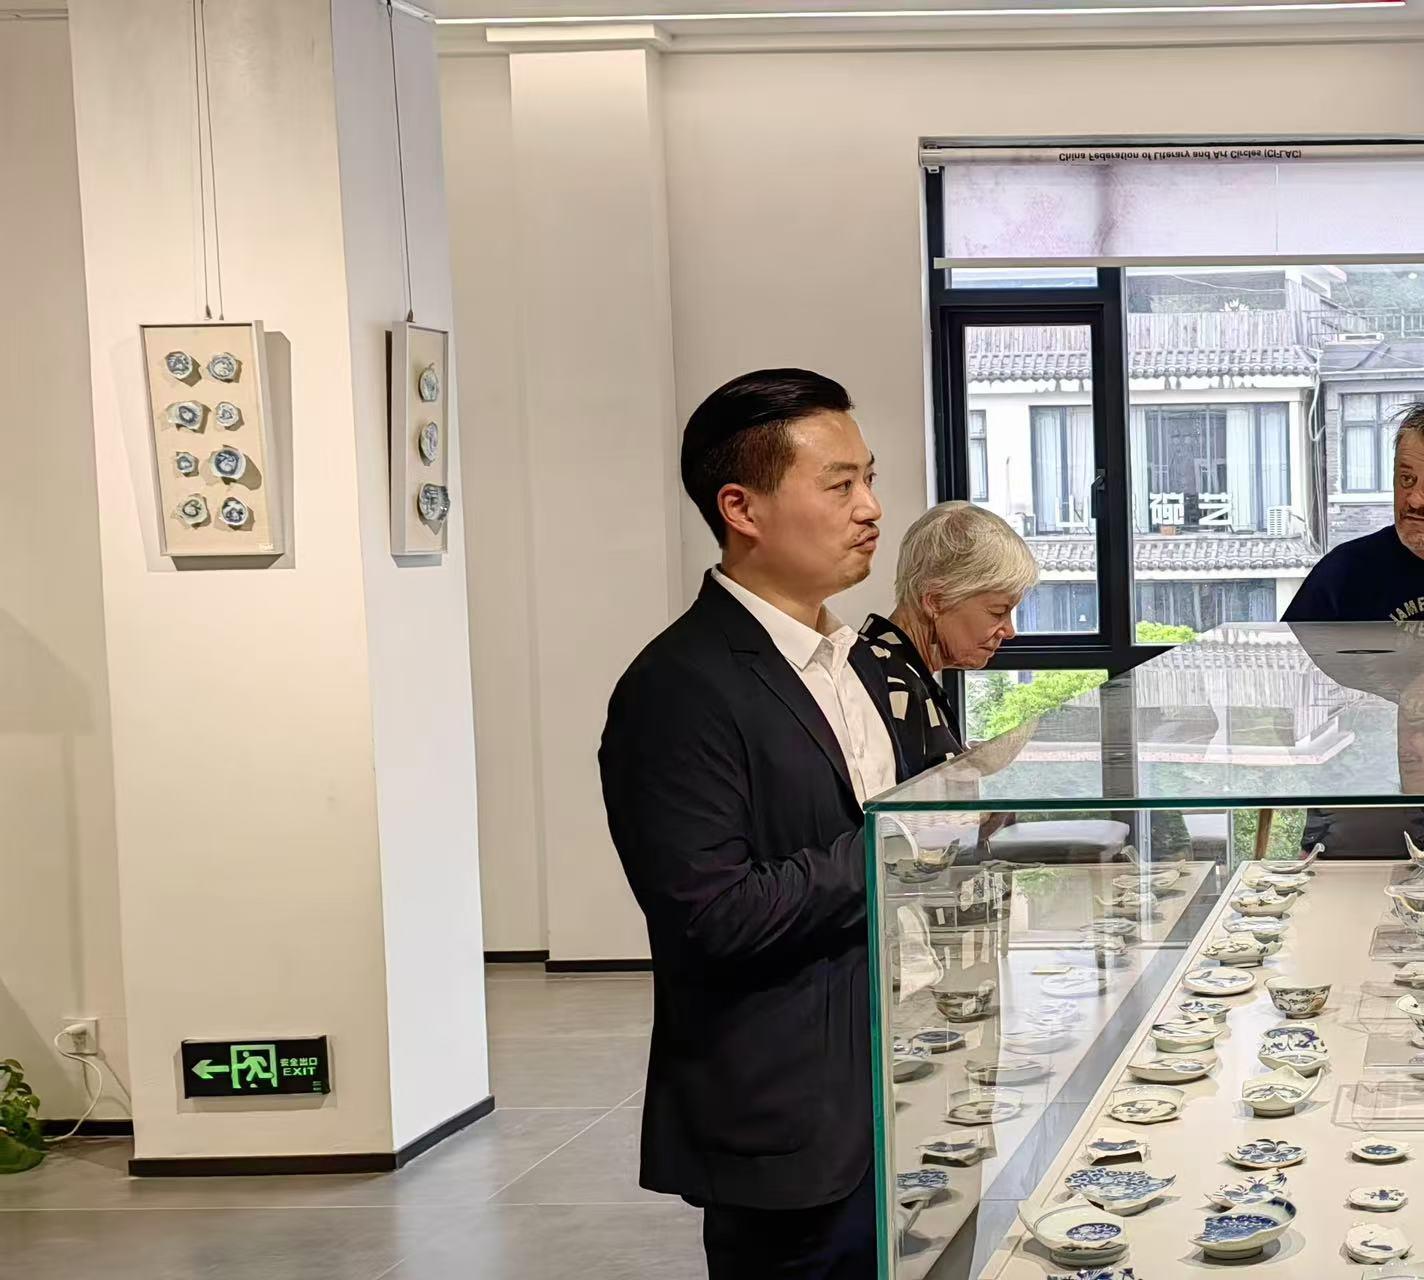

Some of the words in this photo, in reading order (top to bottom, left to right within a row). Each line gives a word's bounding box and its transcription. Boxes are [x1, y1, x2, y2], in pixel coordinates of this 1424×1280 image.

[280, 1057, 318, 1067] 安全出口
[283, 1066, 316, 1076] EXIT
